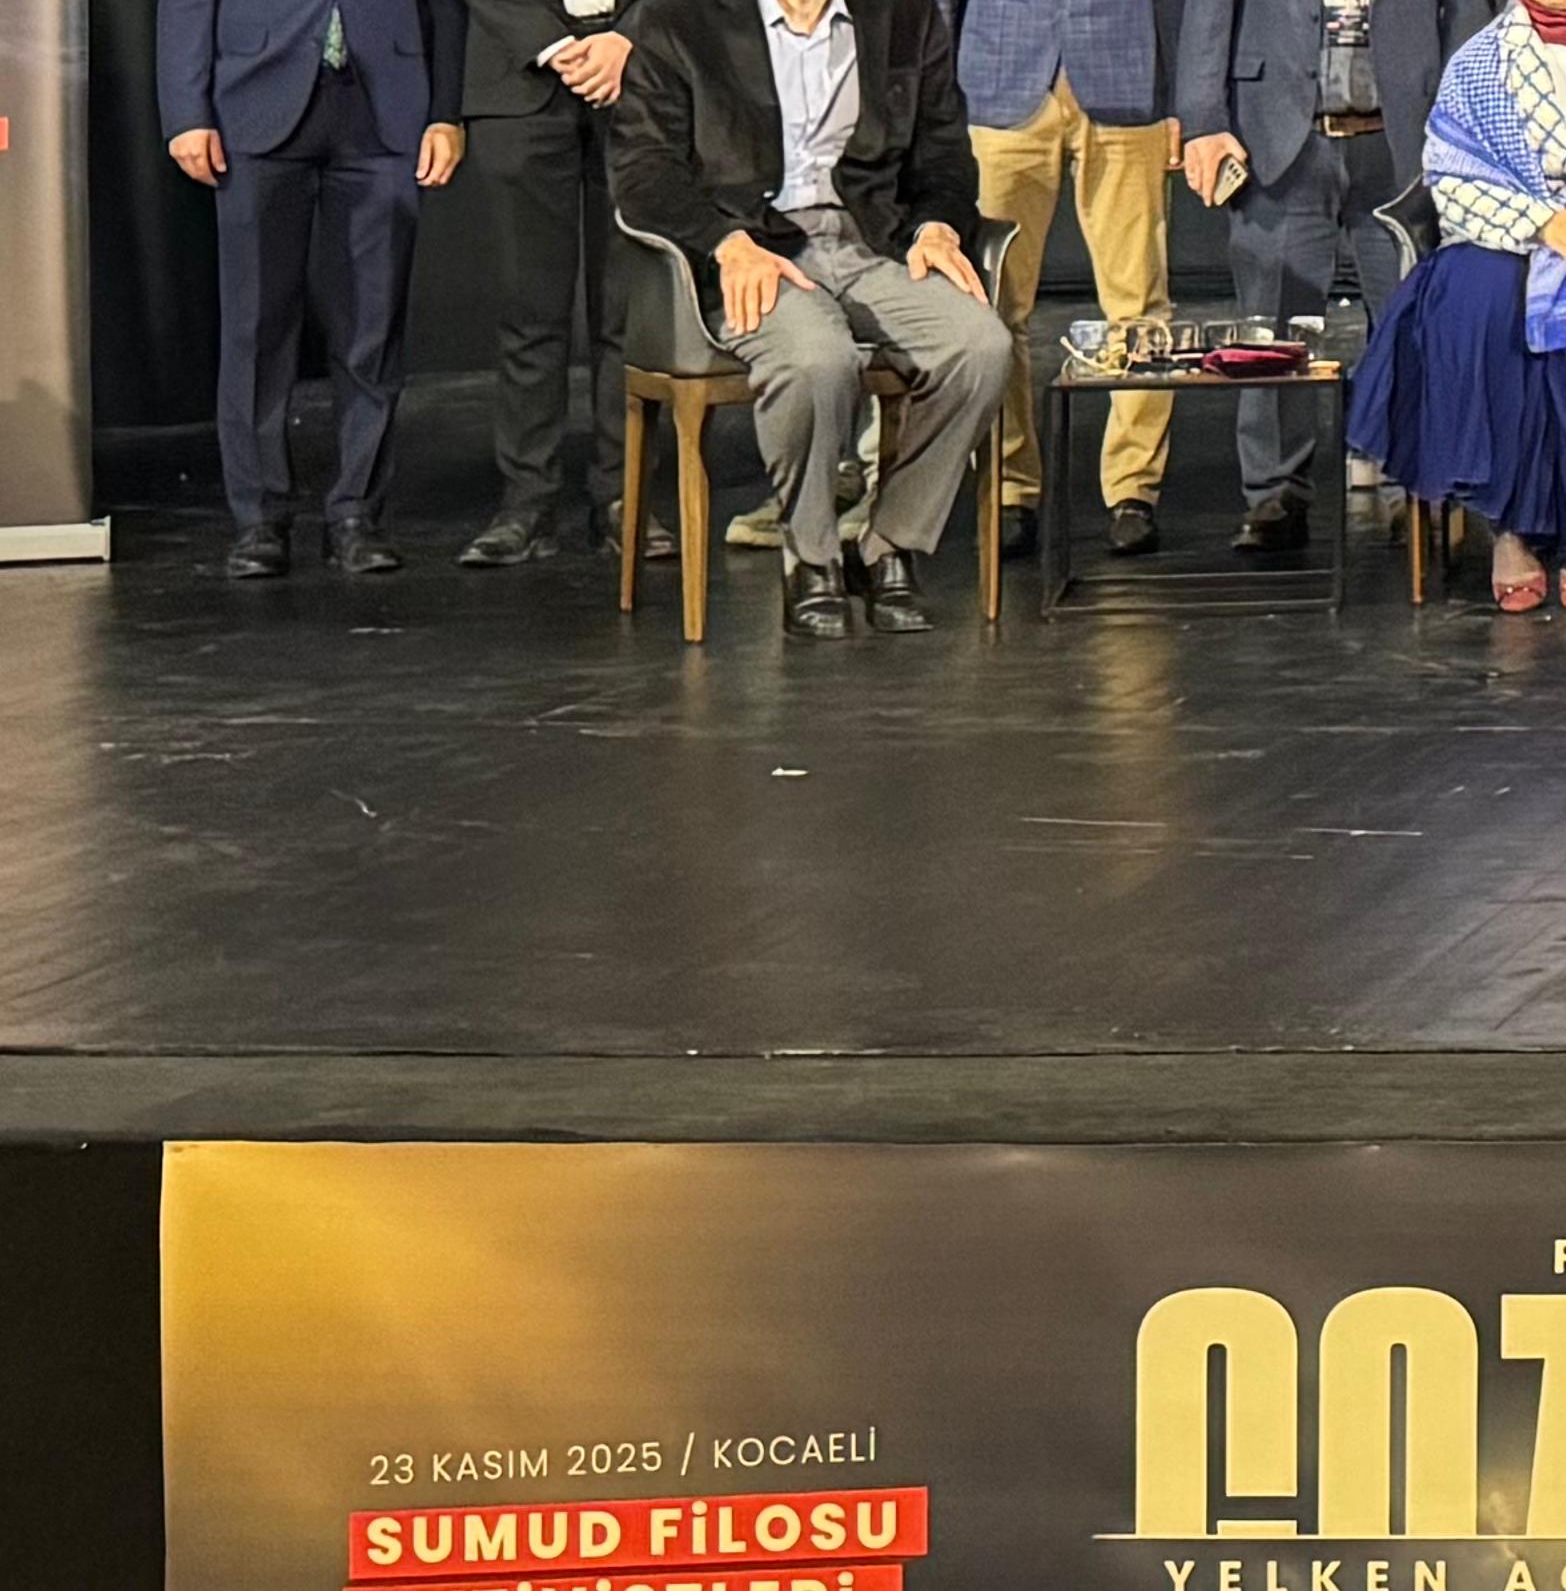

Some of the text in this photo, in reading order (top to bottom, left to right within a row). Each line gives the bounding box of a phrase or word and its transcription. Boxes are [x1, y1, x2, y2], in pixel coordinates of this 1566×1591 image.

[370, 1426, 876, 1485] 23 KASIM 2025 / KOCAELİ
[367, 1501, 897, 1565] SUMUD FİLOSU
[1165, 1560, 1446, 1591] YELKEN
